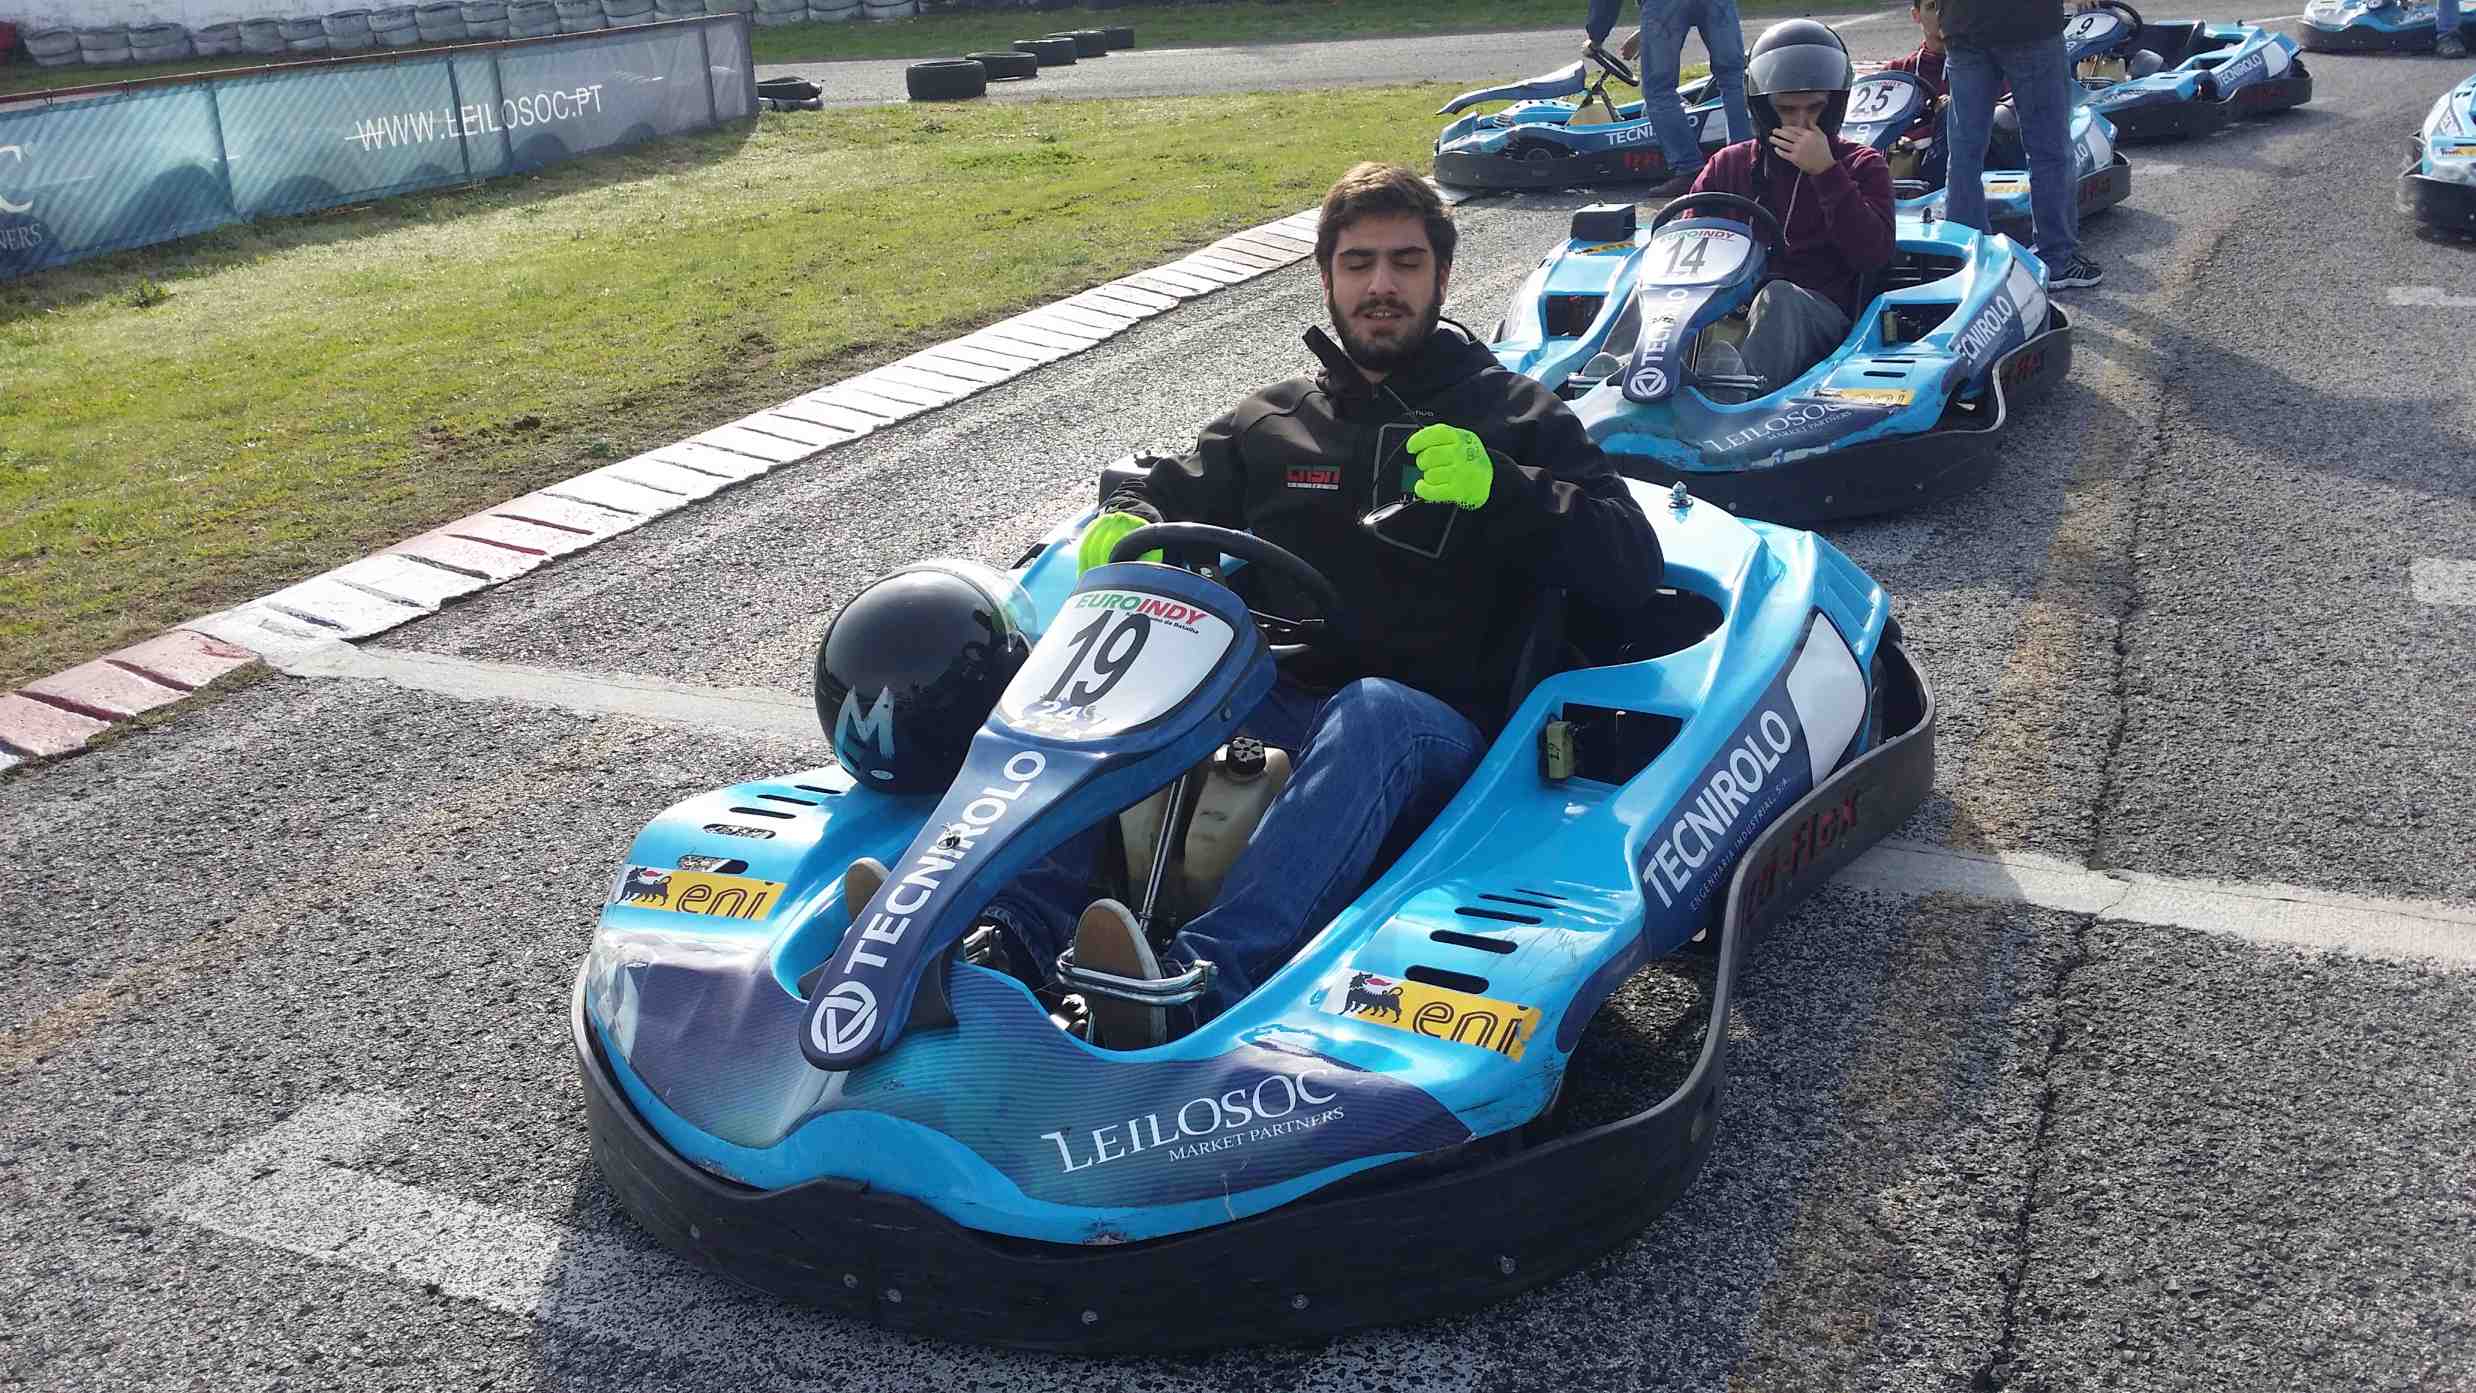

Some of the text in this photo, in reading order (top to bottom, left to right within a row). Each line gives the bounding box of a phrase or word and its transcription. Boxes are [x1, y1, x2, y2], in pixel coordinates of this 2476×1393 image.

[356, 84, 602, 152] WWW.LEILOSOC.PT
[1851, 85, 1894, 113] 25
[1665, 236, 1710, 278] 14
[1075, 594, 1209, 625] EUROINDY
[1040, 609, 1151, 707] 19
[1642, 709, 1792, 909] TECNIROLO
[676, 881, 775, 919] eni
[1412, 1000, 1529, 1056] eni
[1041, 1068, 1338, 1174] LEILOSOC
[1168, 1106, 1346, 1162] MARKET PARTNERS
